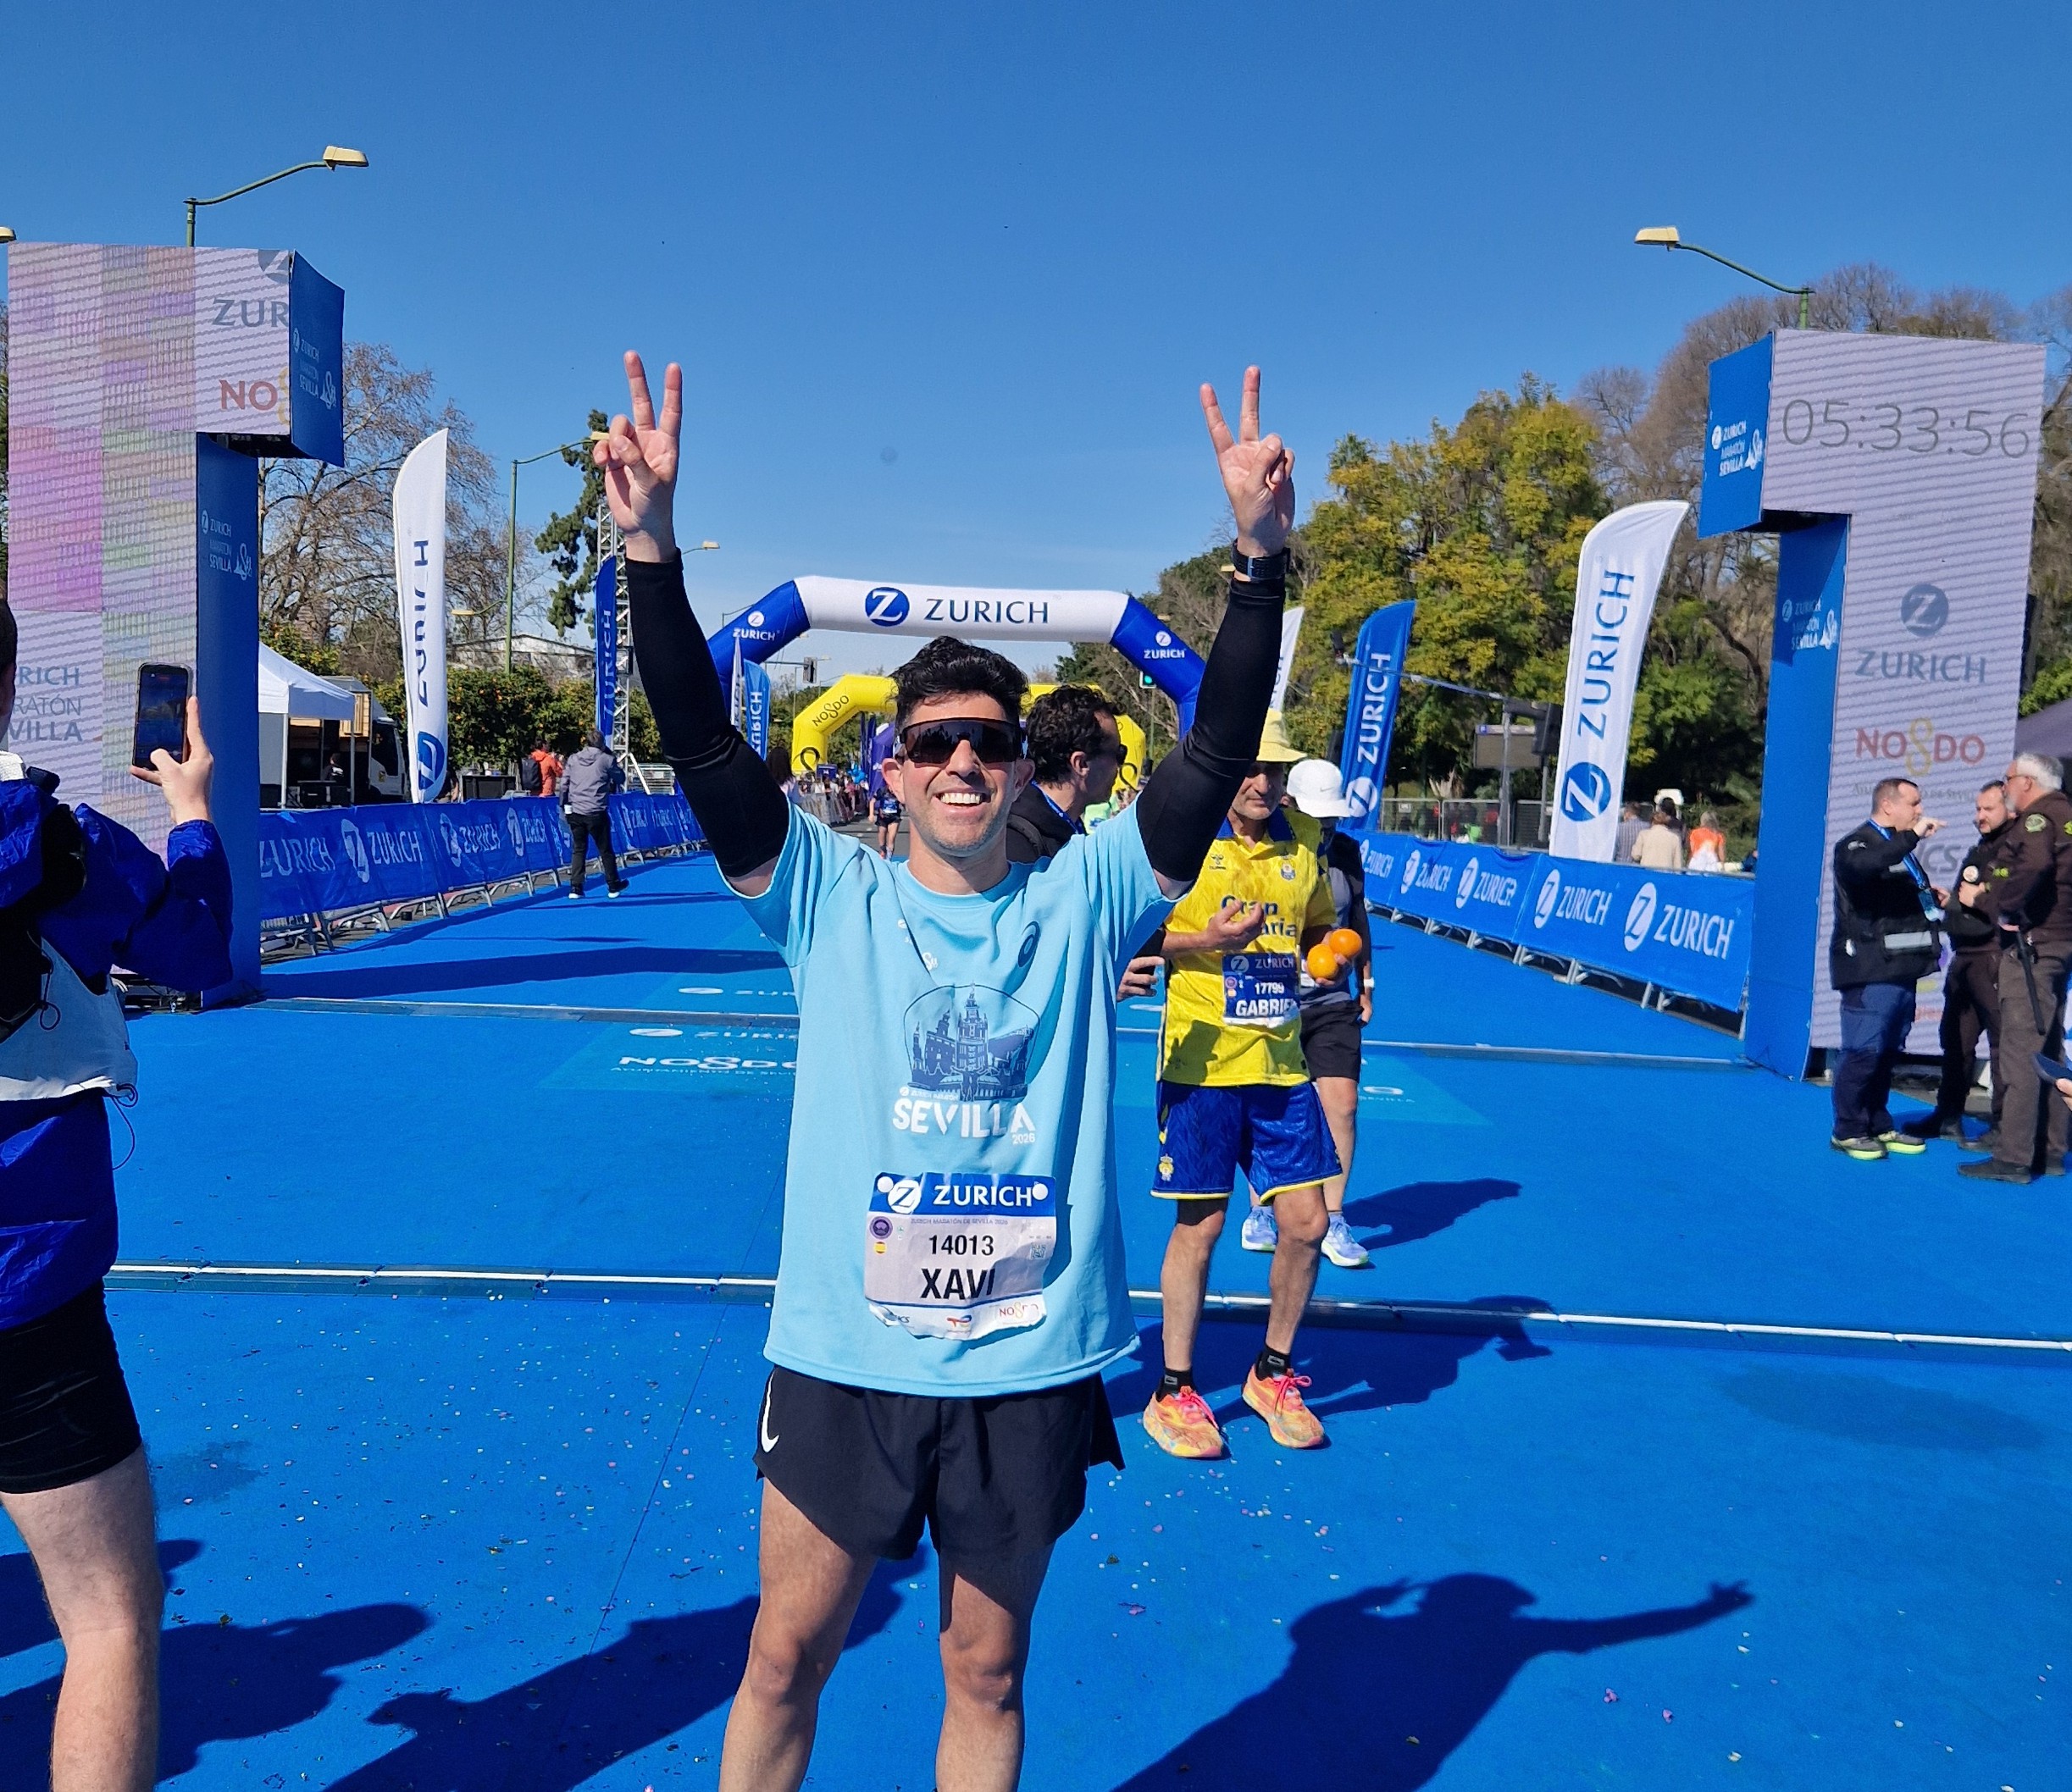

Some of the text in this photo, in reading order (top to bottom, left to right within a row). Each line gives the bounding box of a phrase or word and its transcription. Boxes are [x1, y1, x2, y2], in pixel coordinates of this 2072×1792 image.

[1781, 399, 2030, 459] 05:33:56
[923, 597, 1050, 625] ZURICH
[733, 628, 776, 641] ZURICH
[1144, 649, 1185, 659] ZURICH
[1577, 568, 1636, 741] ZURICH
[1855, 650, 1986, 683] ZURICH
[1357, 652, 1392, 766] ZURICH
[367, 831, 424, 866] ZURICH
[1415, 862, 1454, 892] ZURICH
[1555, 884, 1613, 926] ZURICH
[1654, 903, 1735, 960] ZURICH
[1255, 957, 1294, 969] ZURICH
[1254, 982, 1285, 995] 17799
[1235, 998, 1297, 1017] GABRIE
[892, 1098, 1036, 1137] SEVILLA
[1011, 1132, 1036, 1144] 2026
[933, 1185, 1033, 1207] ZURICH
[928, 1234, 994, 1256] 14013
[920, 1267, 996, 1300] XAVI
